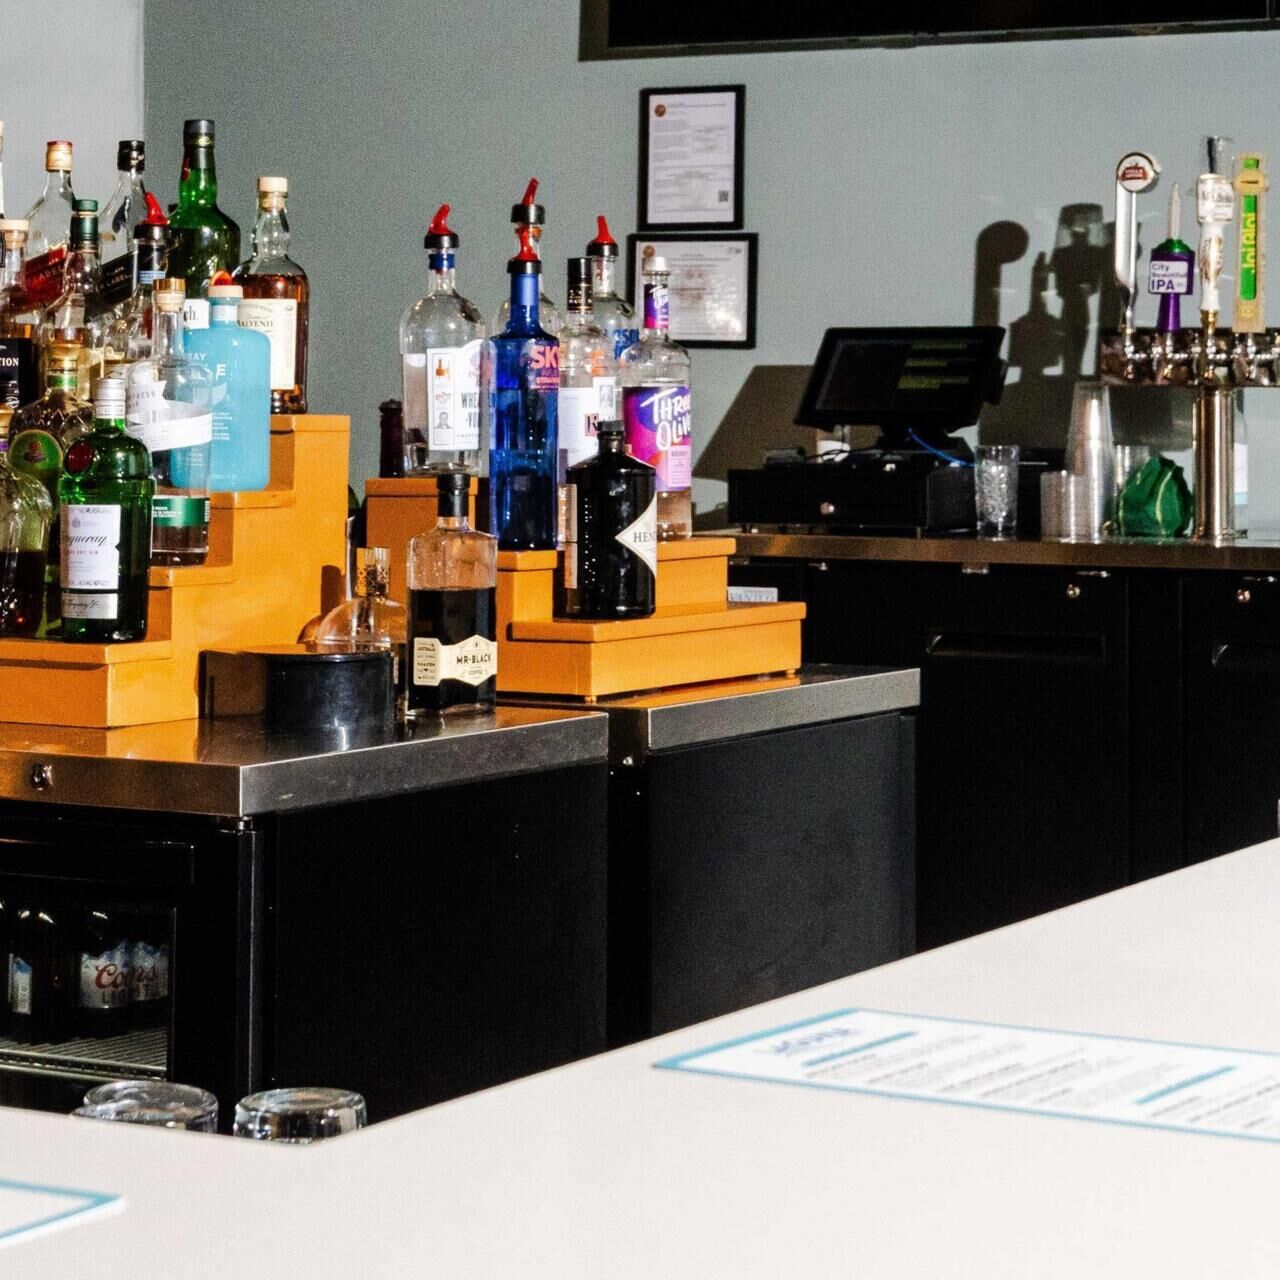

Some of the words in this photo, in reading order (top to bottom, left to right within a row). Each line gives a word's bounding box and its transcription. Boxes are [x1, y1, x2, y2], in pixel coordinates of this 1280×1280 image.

[1151, 263, 1170, 272] City
[1151, 279, 1175, 291] IPA
[238, 319, 274, 328] ALVENIE
